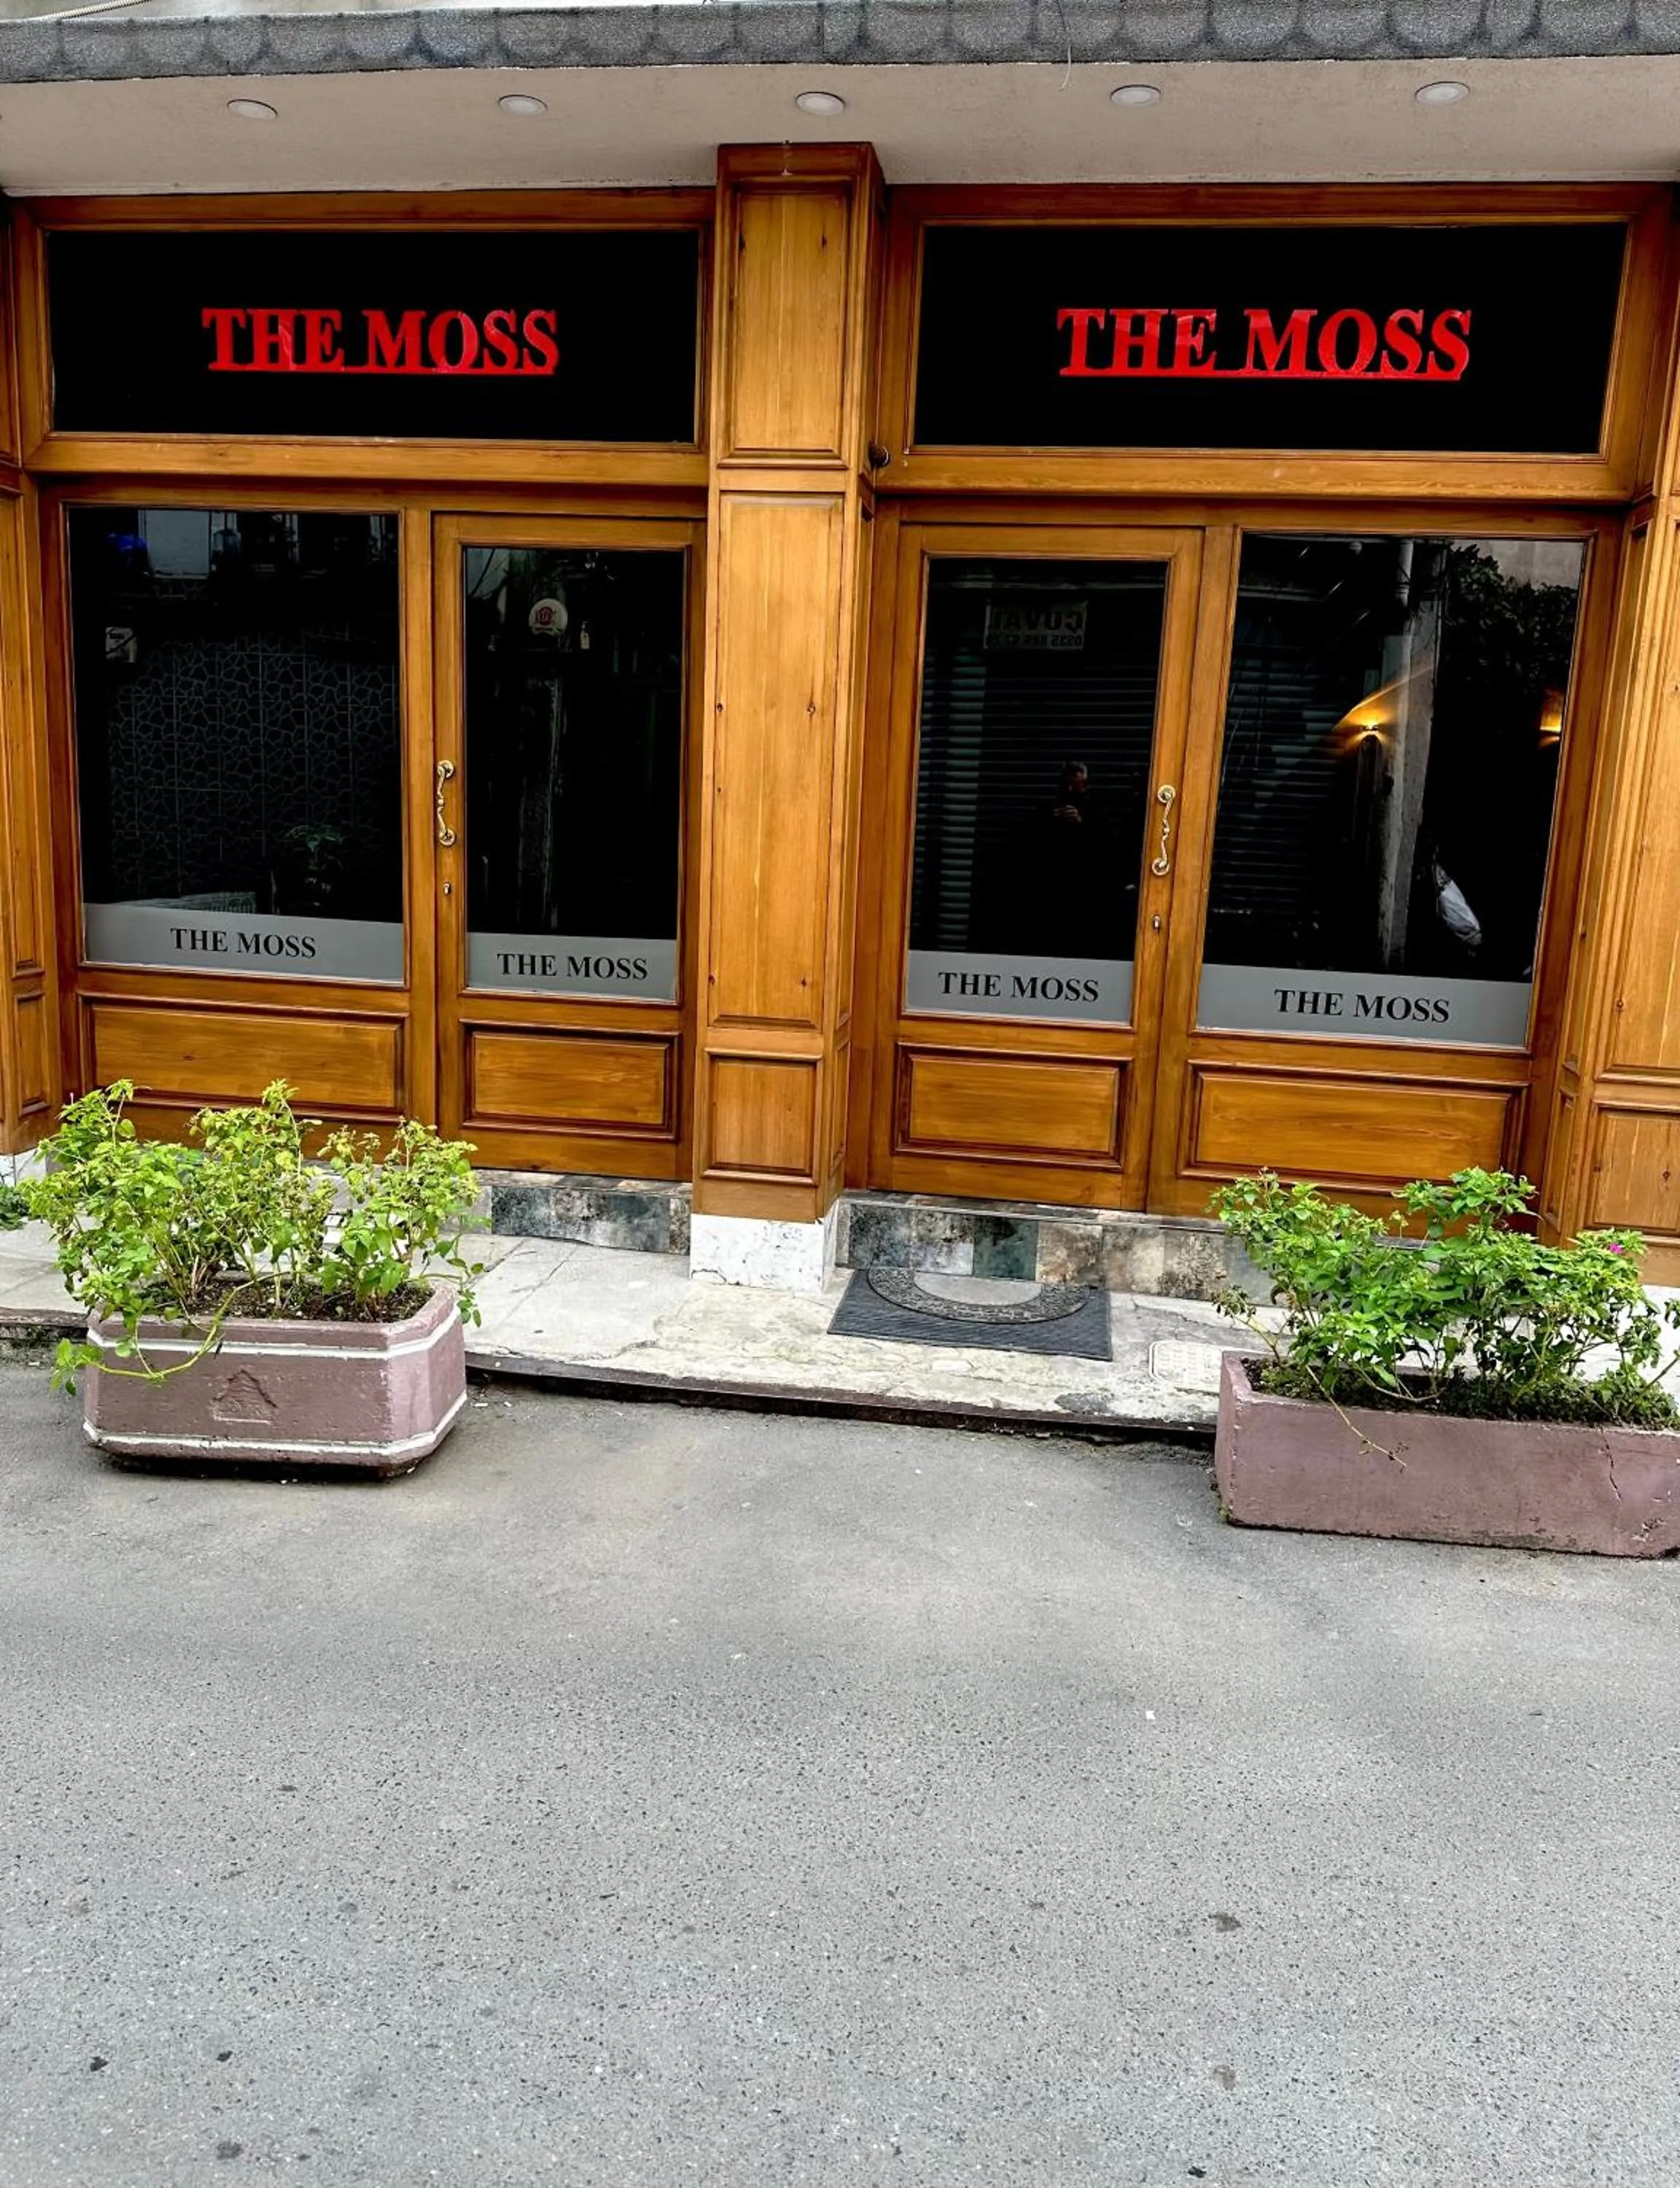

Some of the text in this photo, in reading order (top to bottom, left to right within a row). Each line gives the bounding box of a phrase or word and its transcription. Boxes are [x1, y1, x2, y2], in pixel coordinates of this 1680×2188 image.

[201, 308, 559, 374] THE MOSS
[1057, 309, 1471, 380] THE MOSS
[170, 928, 316, 958] THE MOSS
[497, 953, 648, 981] THE MOSS
[938, 971, 1099, 1002] THE MOSS
[1274, 989, 1450, 1023] THE MOSS
